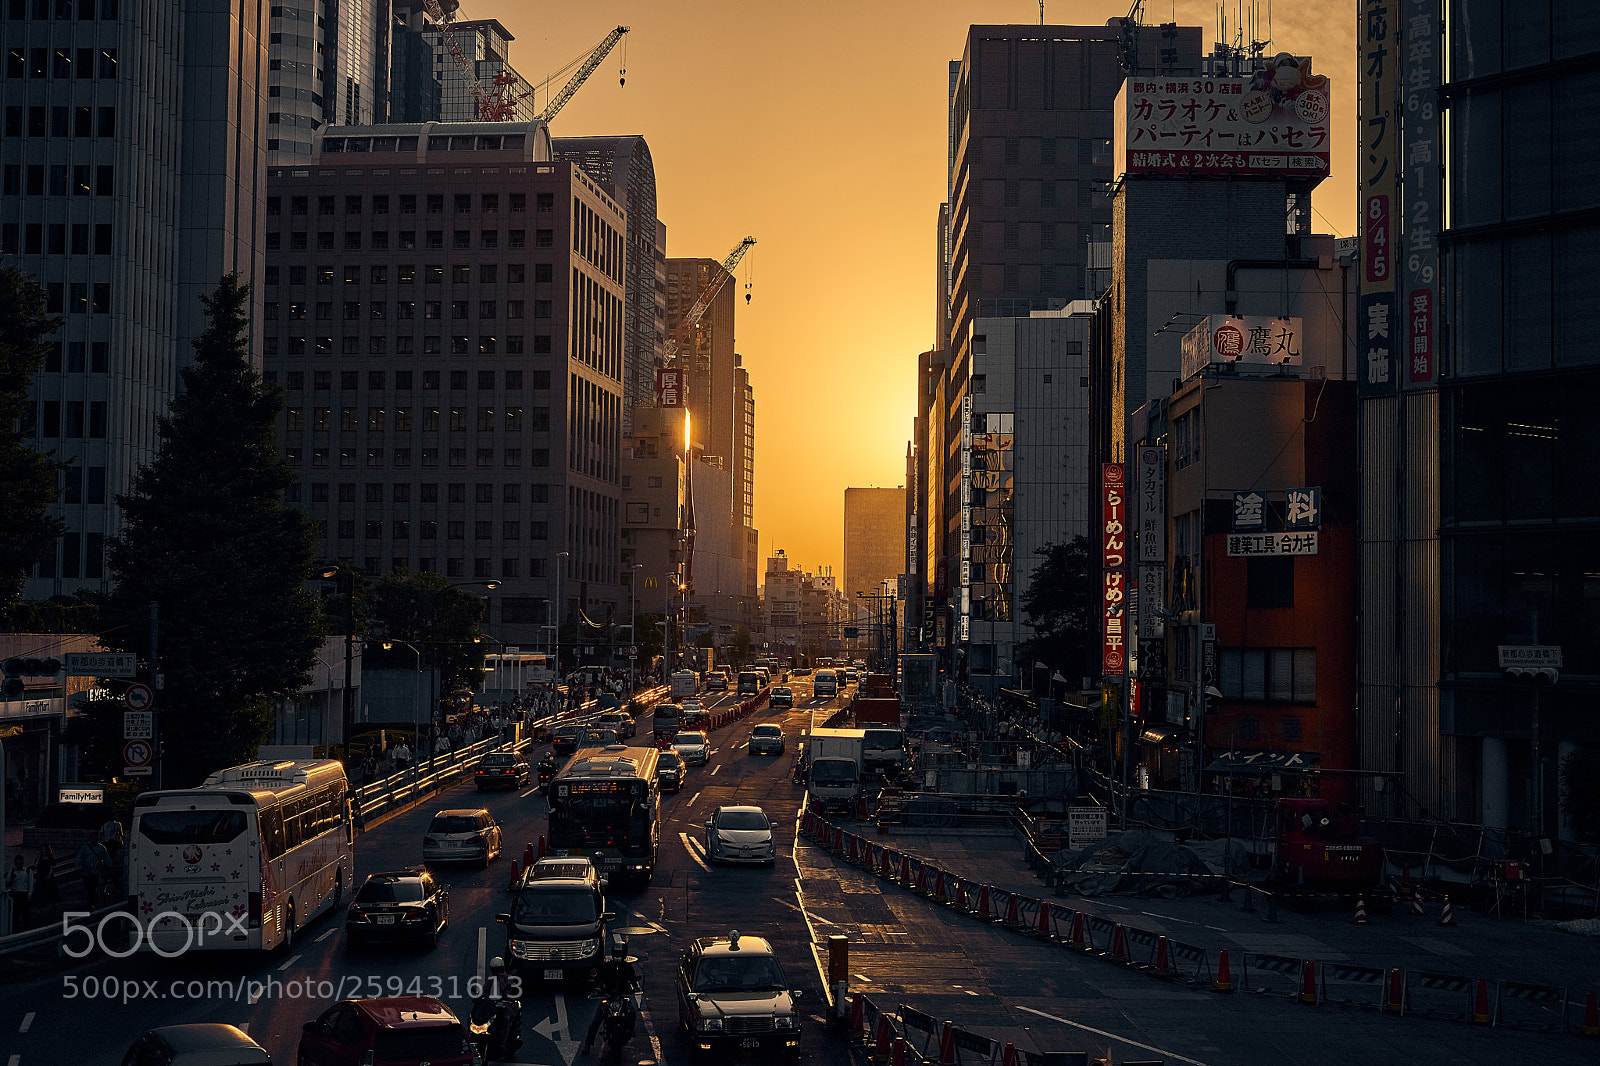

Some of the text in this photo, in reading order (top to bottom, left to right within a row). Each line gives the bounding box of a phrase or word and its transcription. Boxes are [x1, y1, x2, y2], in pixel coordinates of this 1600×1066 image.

[1367, 0, 1389, 187] 応オープン
[1132, 124, 1327, 149] パーティーはパセラ
[1246, 326, 1300, 356] 鷹丸
[1367, 302, 1389, 384] 実施
[1413, 294, 1428, 374] 受付開始
[925, 600, 934, 639] エフワン
[26, 701, 50, 713] FamilyMart
[1219, 751, 1303, 766] ペイント
[60, 792, 102, 802] FamilyMart
